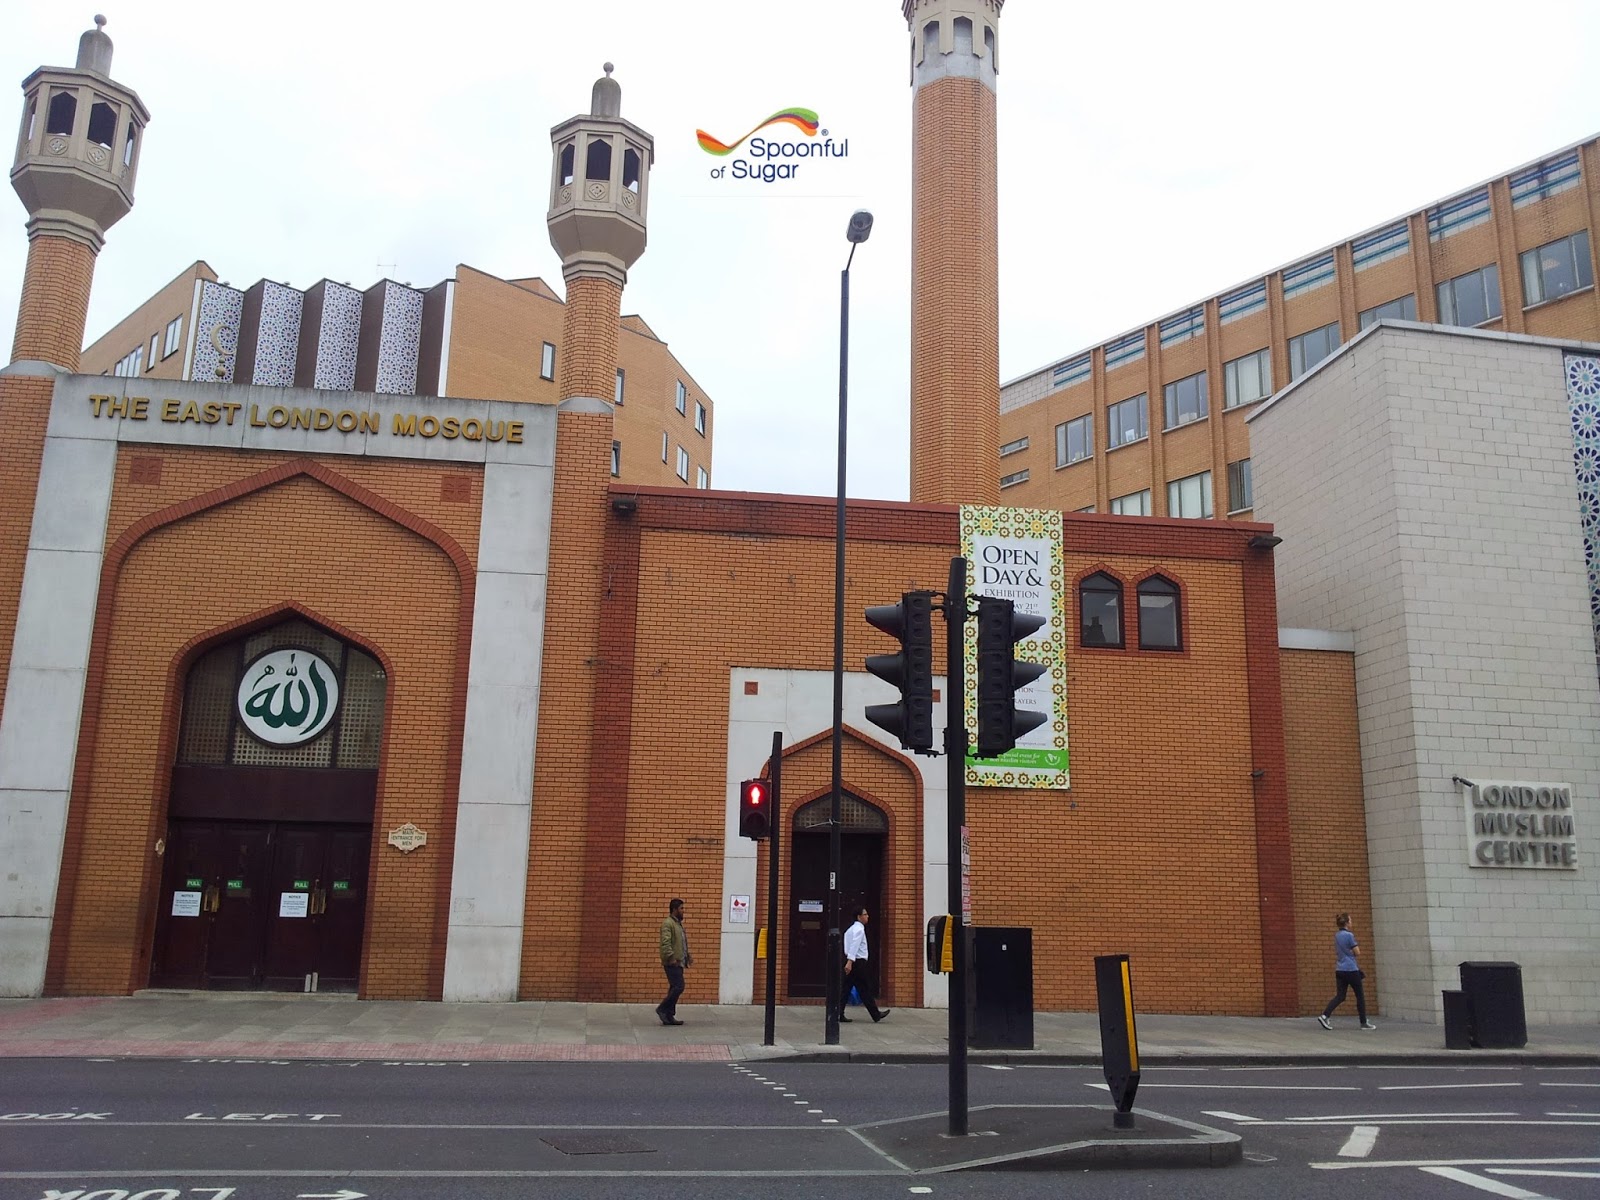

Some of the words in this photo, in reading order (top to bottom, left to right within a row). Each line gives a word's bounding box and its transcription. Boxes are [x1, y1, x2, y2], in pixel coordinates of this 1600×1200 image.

[89, 394, 150, 421] THE
[161, 399, 242, 425] EAST
[250, 404, 381, 435] LONDON
[392, 413, 525, 444] MOSQUE
[982, 545, 1040, 566] OPEN
[984, 588, 1040, 599] EXHIBITION
[1471, 784, 1572, 809] LONDON
[1474, 812, 1575, 836] MUSLIM
[1475, 840, 1578, 865] CENTRE
[0, 1112, 115, 1121] OOK
[184, 1112, 342, 1121] LEFT
